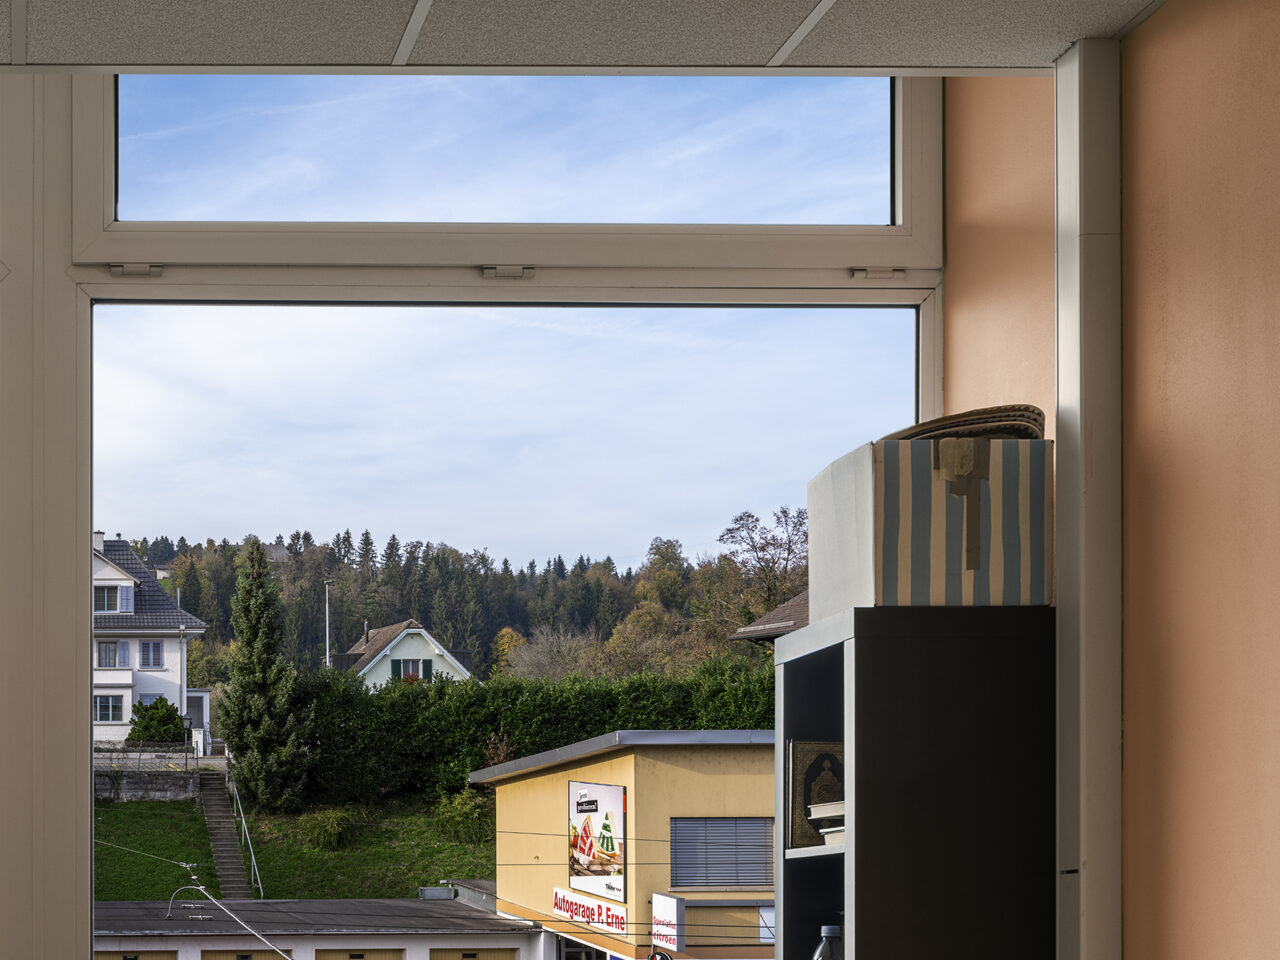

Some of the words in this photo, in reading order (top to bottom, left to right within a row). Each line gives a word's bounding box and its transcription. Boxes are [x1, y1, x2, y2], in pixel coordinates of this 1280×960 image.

[553, 891, 595, 925] Autogarage
[597, 904, 604, 924] P.
[605, 906, 626, 931] Erne
